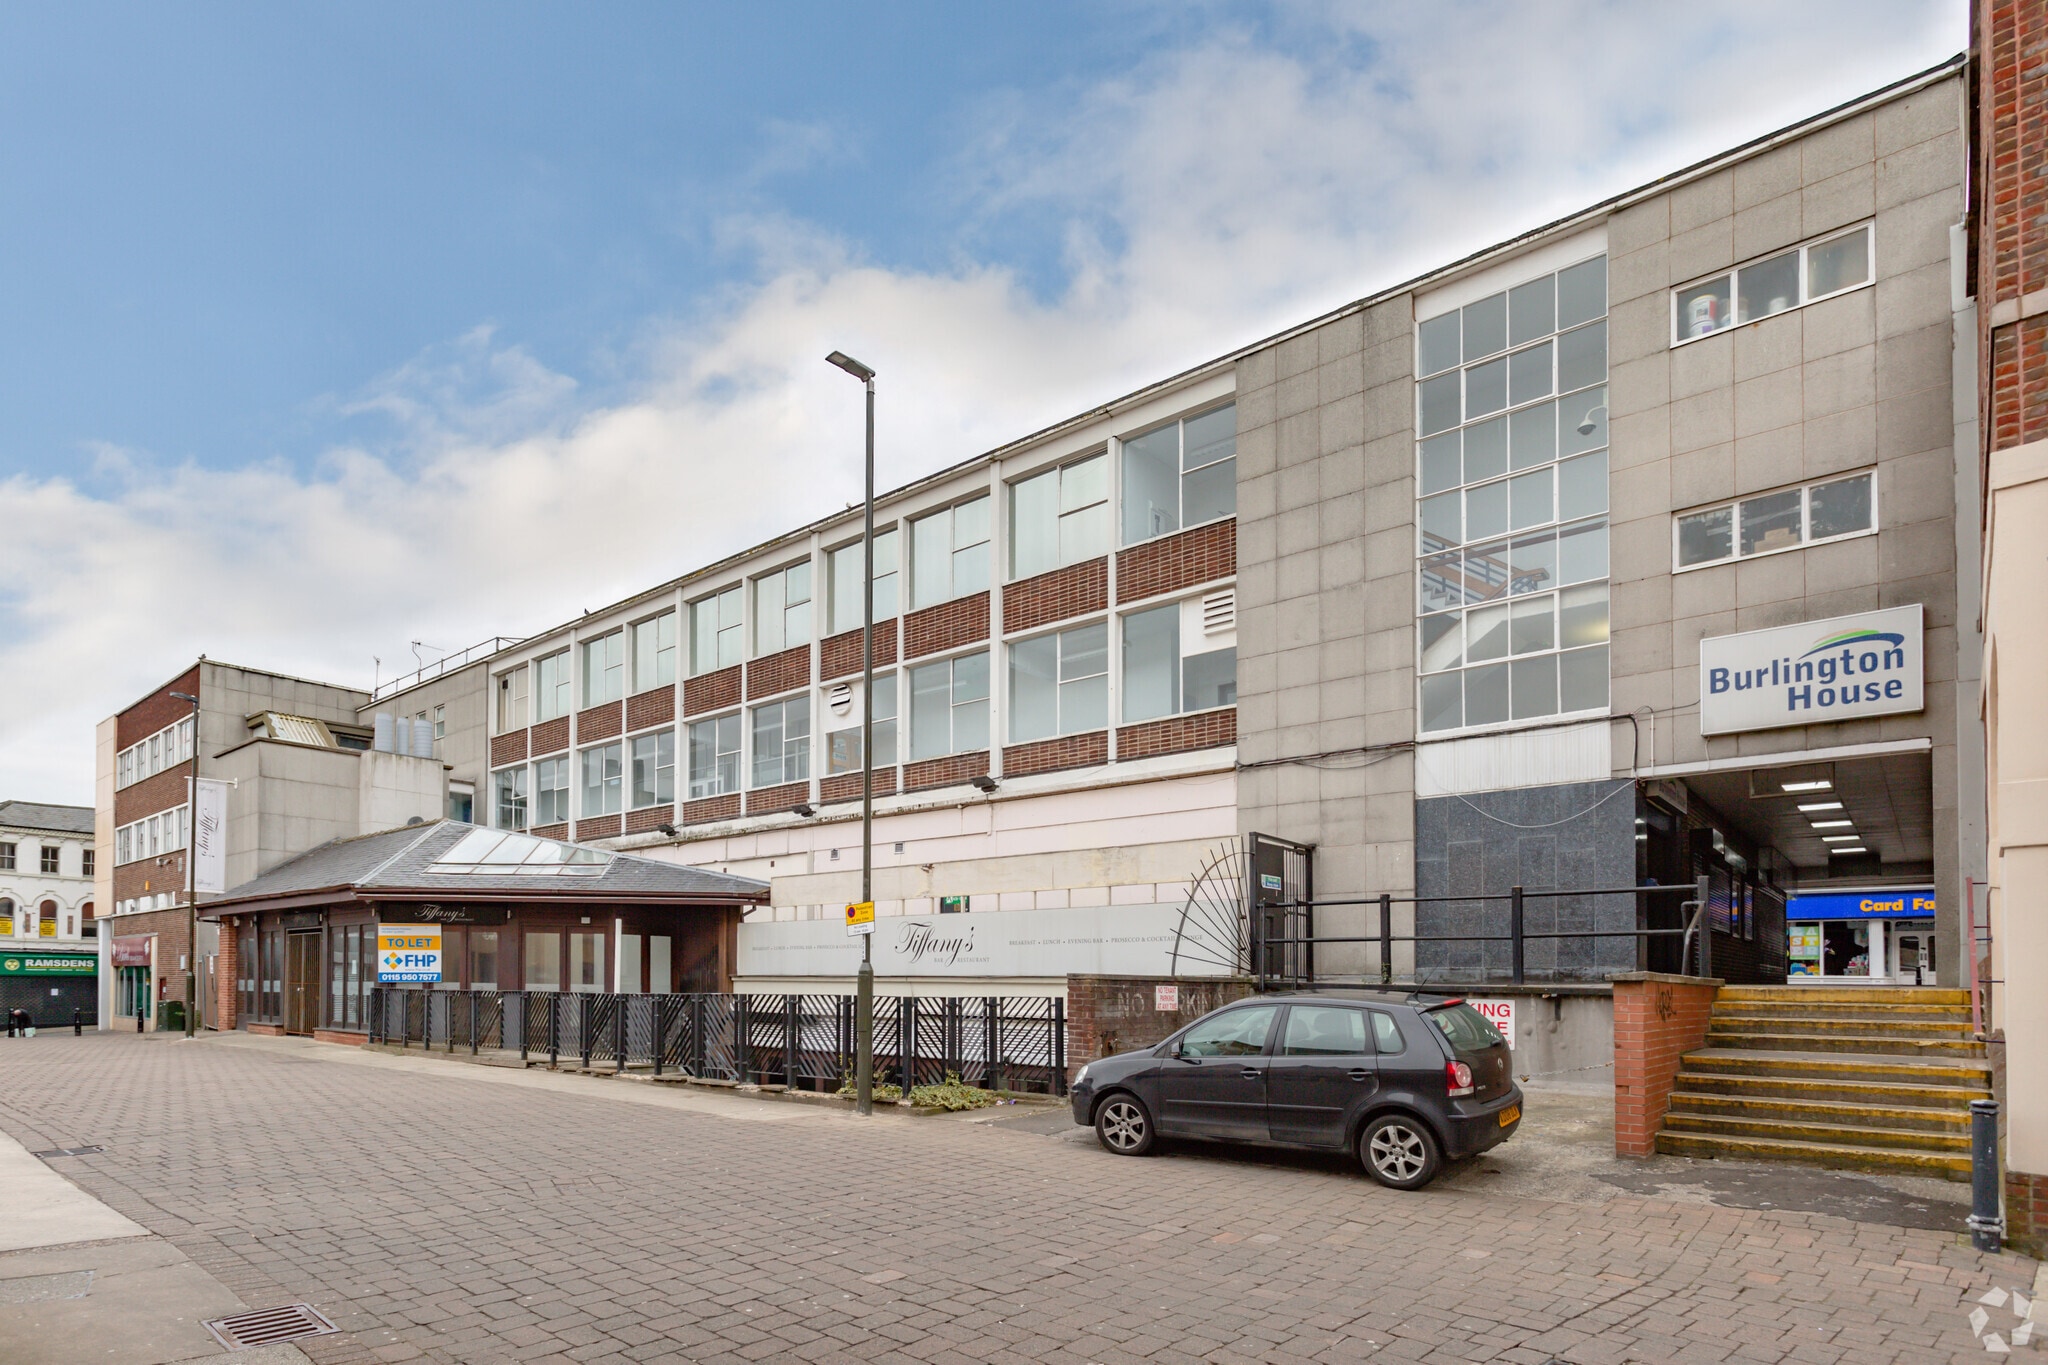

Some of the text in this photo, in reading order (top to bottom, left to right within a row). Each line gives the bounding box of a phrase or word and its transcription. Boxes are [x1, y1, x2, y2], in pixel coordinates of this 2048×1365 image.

[1709, 647, 1904, 695] Burlington
[1788, 679, 1903, 711] House
[415, 904, 466, 922] Tiffany's
[1859, 899, 1904, 912] Card
[387, 938, 432, 947] TO LET
[894, 921, 975, 967] Tiffany's
[25, 959, 95, 967] RAMSDENS
[405, 954, 437, 967] FHP
[1118, 992, 1145, 1017] NO
